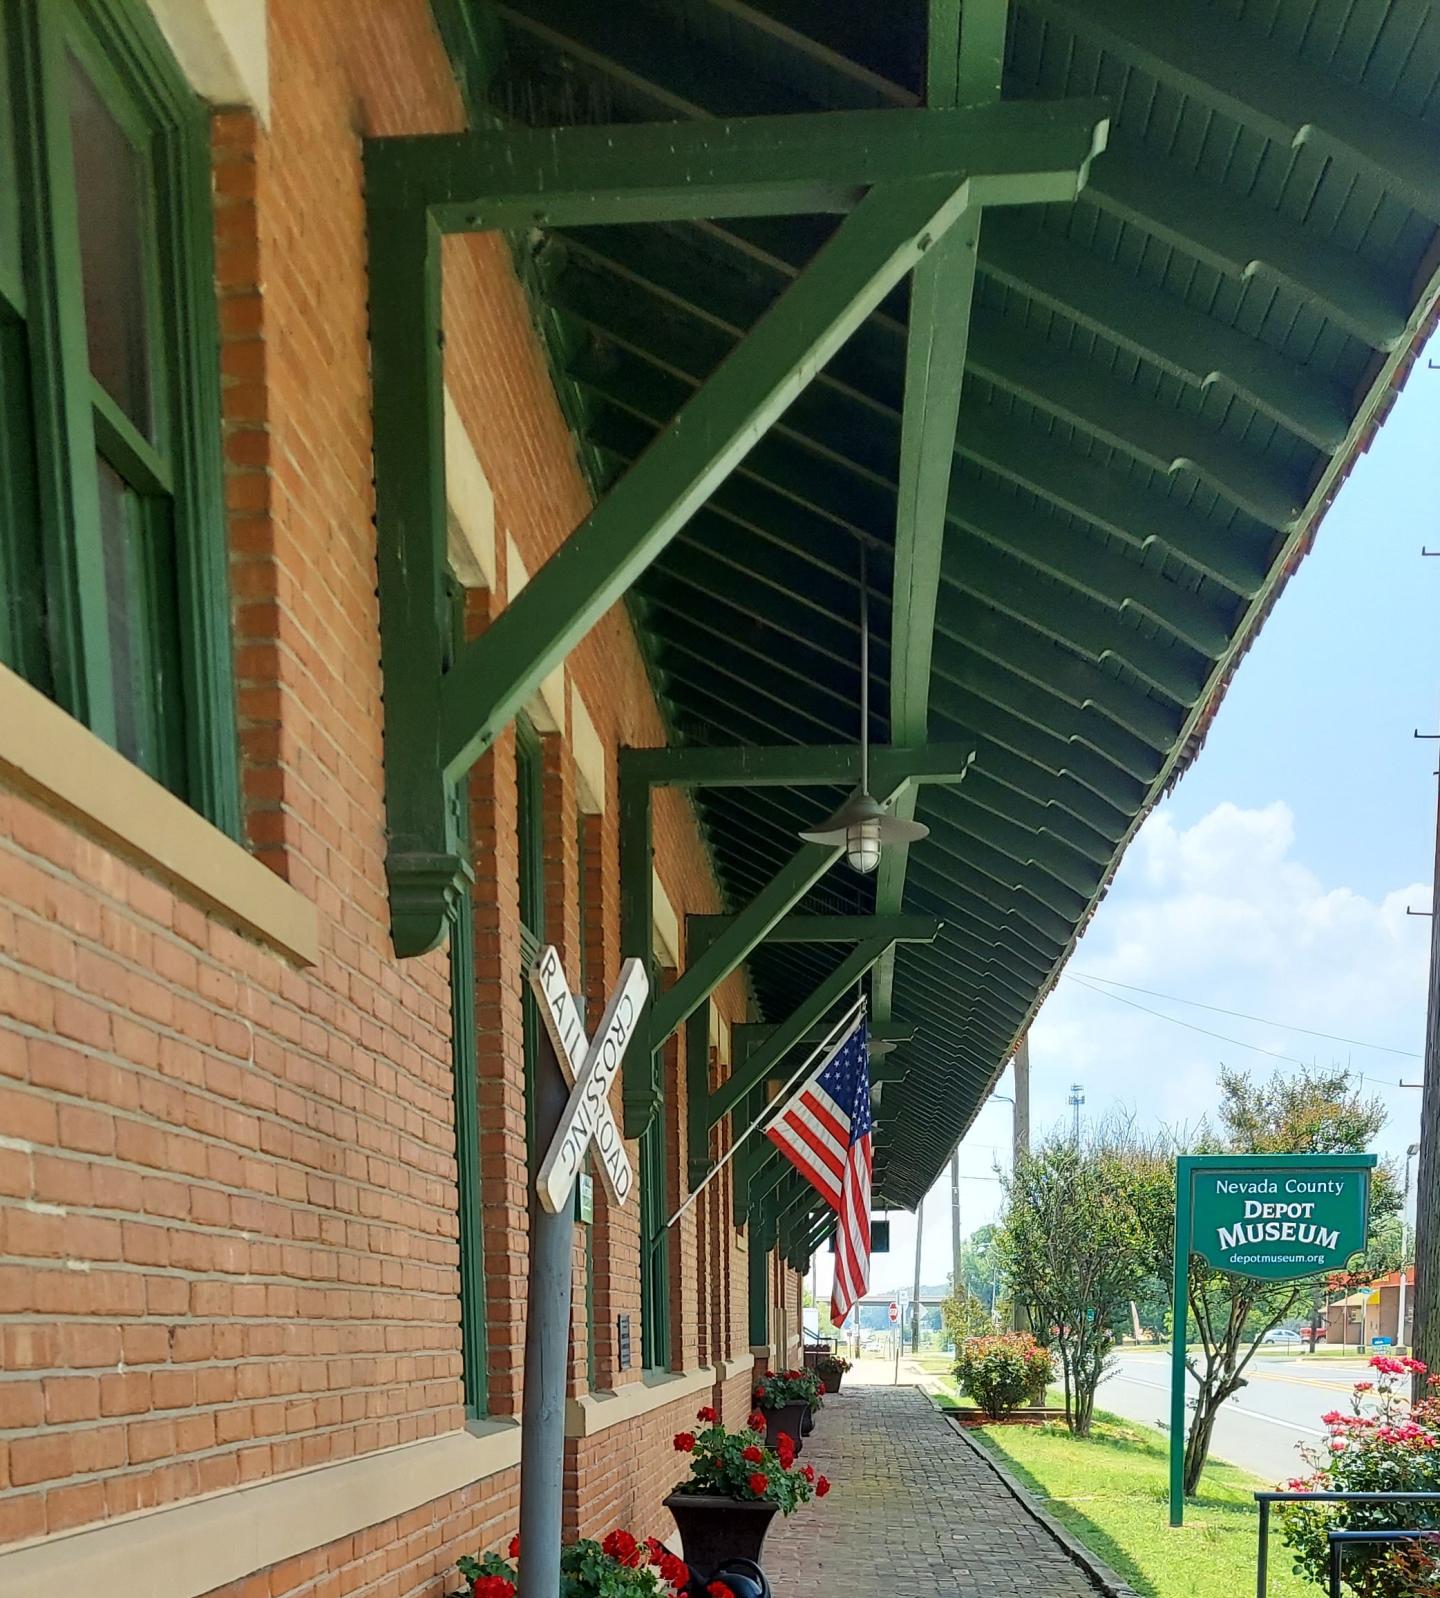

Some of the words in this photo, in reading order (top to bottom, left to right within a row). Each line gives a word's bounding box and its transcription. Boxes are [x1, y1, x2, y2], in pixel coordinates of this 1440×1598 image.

[561, 993, 635, 1177] CROSSING
[1216, 1179, 1278, 1194] Nevada
[1285, 1179, 1344, 1196] County
[1244, 1200, 1315, 1219] DEPOT
[1216, 1221, 1341, 1251] MUSEUM
[1229, 1253, 1325, 1265] depotmuseum.org
